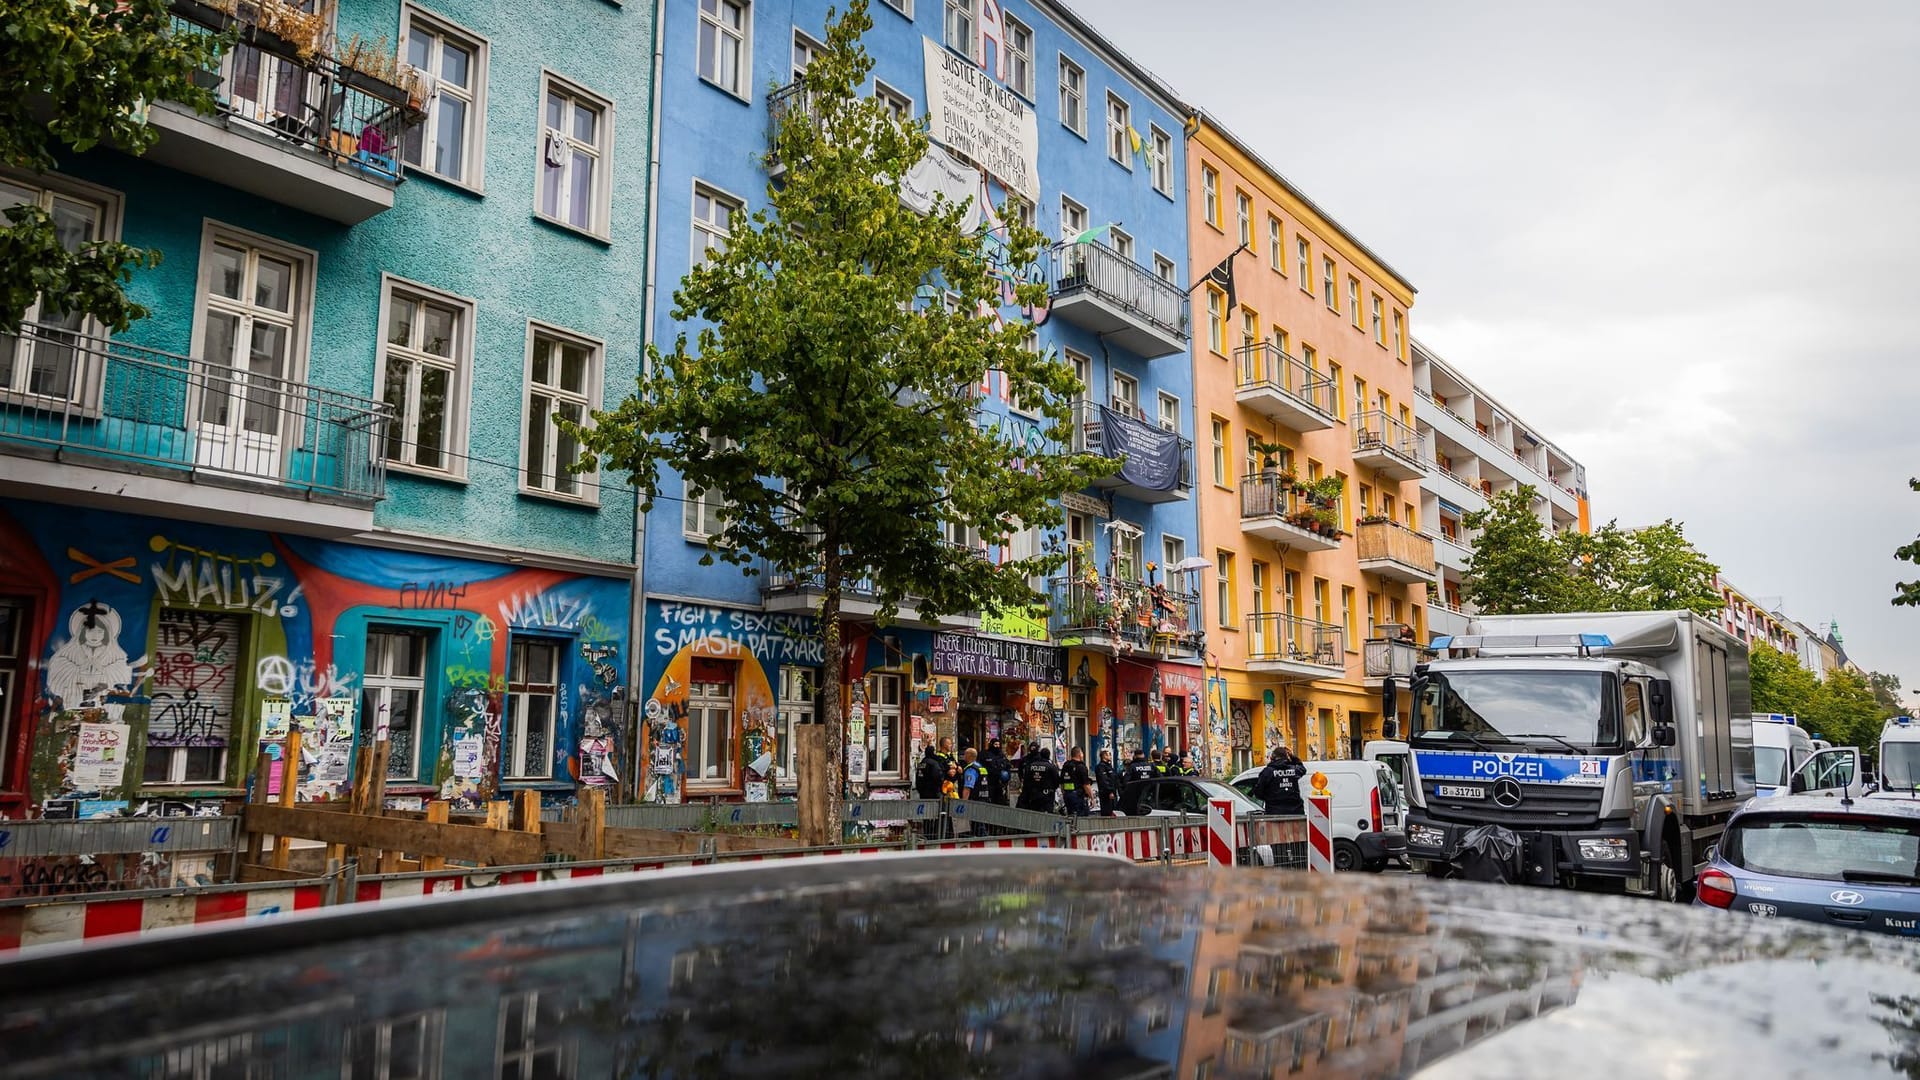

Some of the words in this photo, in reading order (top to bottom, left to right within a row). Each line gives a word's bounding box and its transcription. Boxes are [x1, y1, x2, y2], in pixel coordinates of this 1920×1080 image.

[941, 52, 976, 88] JUSTICE
[978, 73, 993, 100] FOR
[994, 84, 1024, 121] NELSON
[944, 125, 975, 158] GERMANY
[152, 560, 304, 618] MAUZ!
[654, 627, 742, 656] SMASH
[933, 633, 961, 652] UNSERE
[933, 651, 945, 672] IST
[978, 655, 991, 674] ALS
[1273, 769, 1296, 777] POLIZEI
[1472, 760, 1543, 777] POLIZEI
[1582, 762, 1589, 773] 2
[1592, 762, 1599, 773] T
[1442, 787, 1449, 795] B
